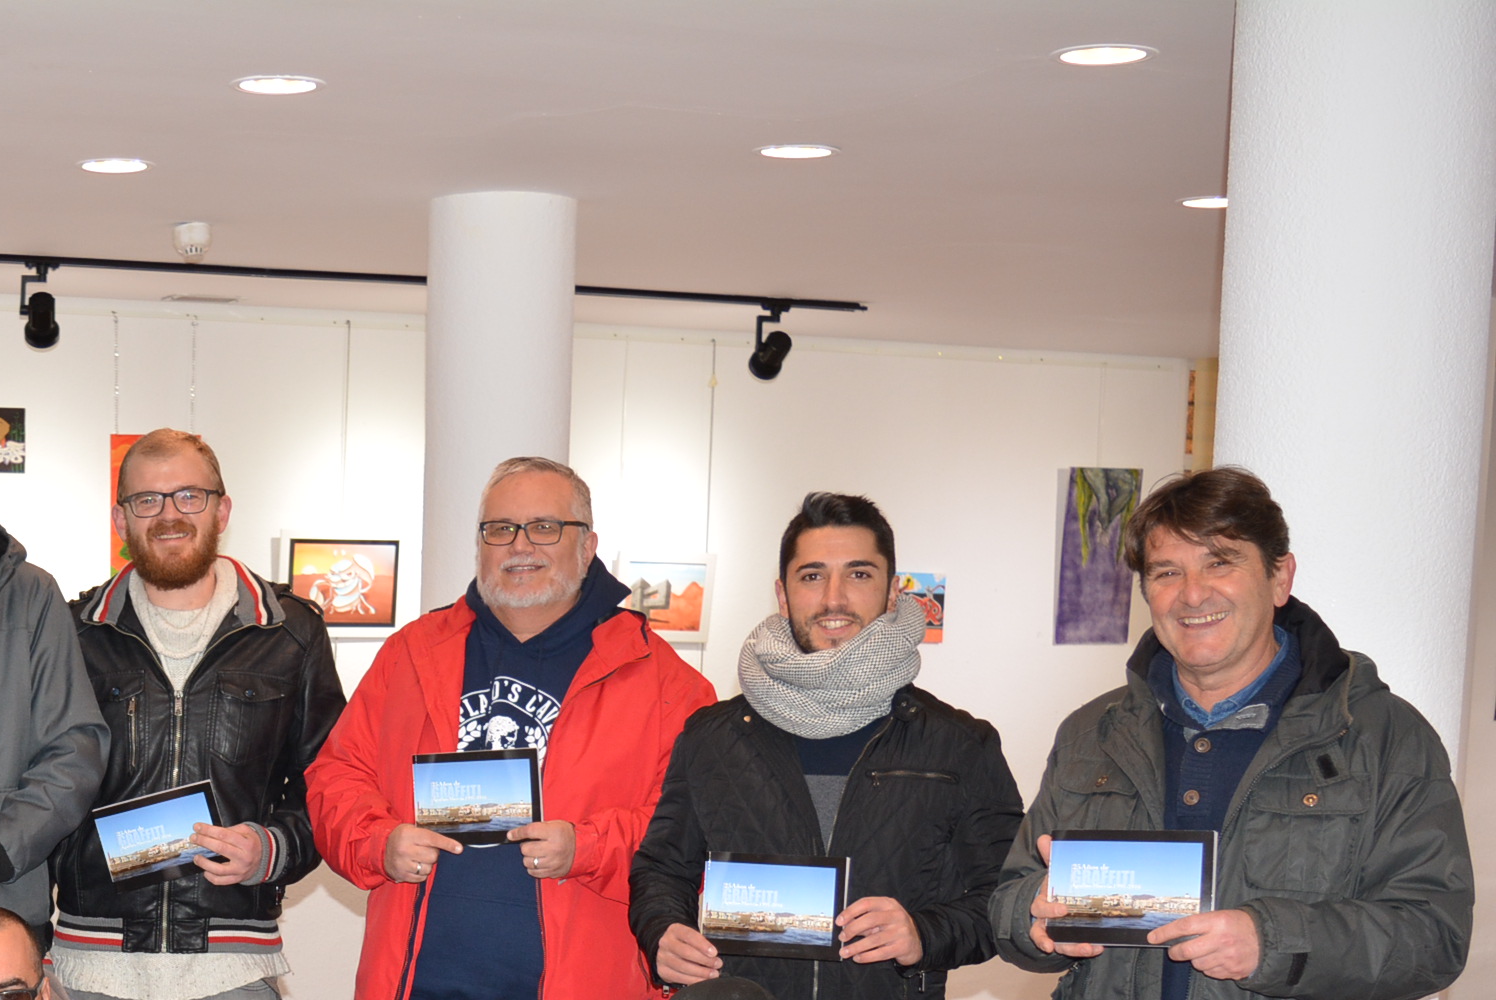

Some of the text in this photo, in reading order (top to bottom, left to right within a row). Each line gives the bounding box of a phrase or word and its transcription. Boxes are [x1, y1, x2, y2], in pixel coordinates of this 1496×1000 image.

[525, 694, 561, 734] CAV
[1071, 870, 1135, 885] GRAFFITI
[723, 888, 778, 903] GRAFFITI
